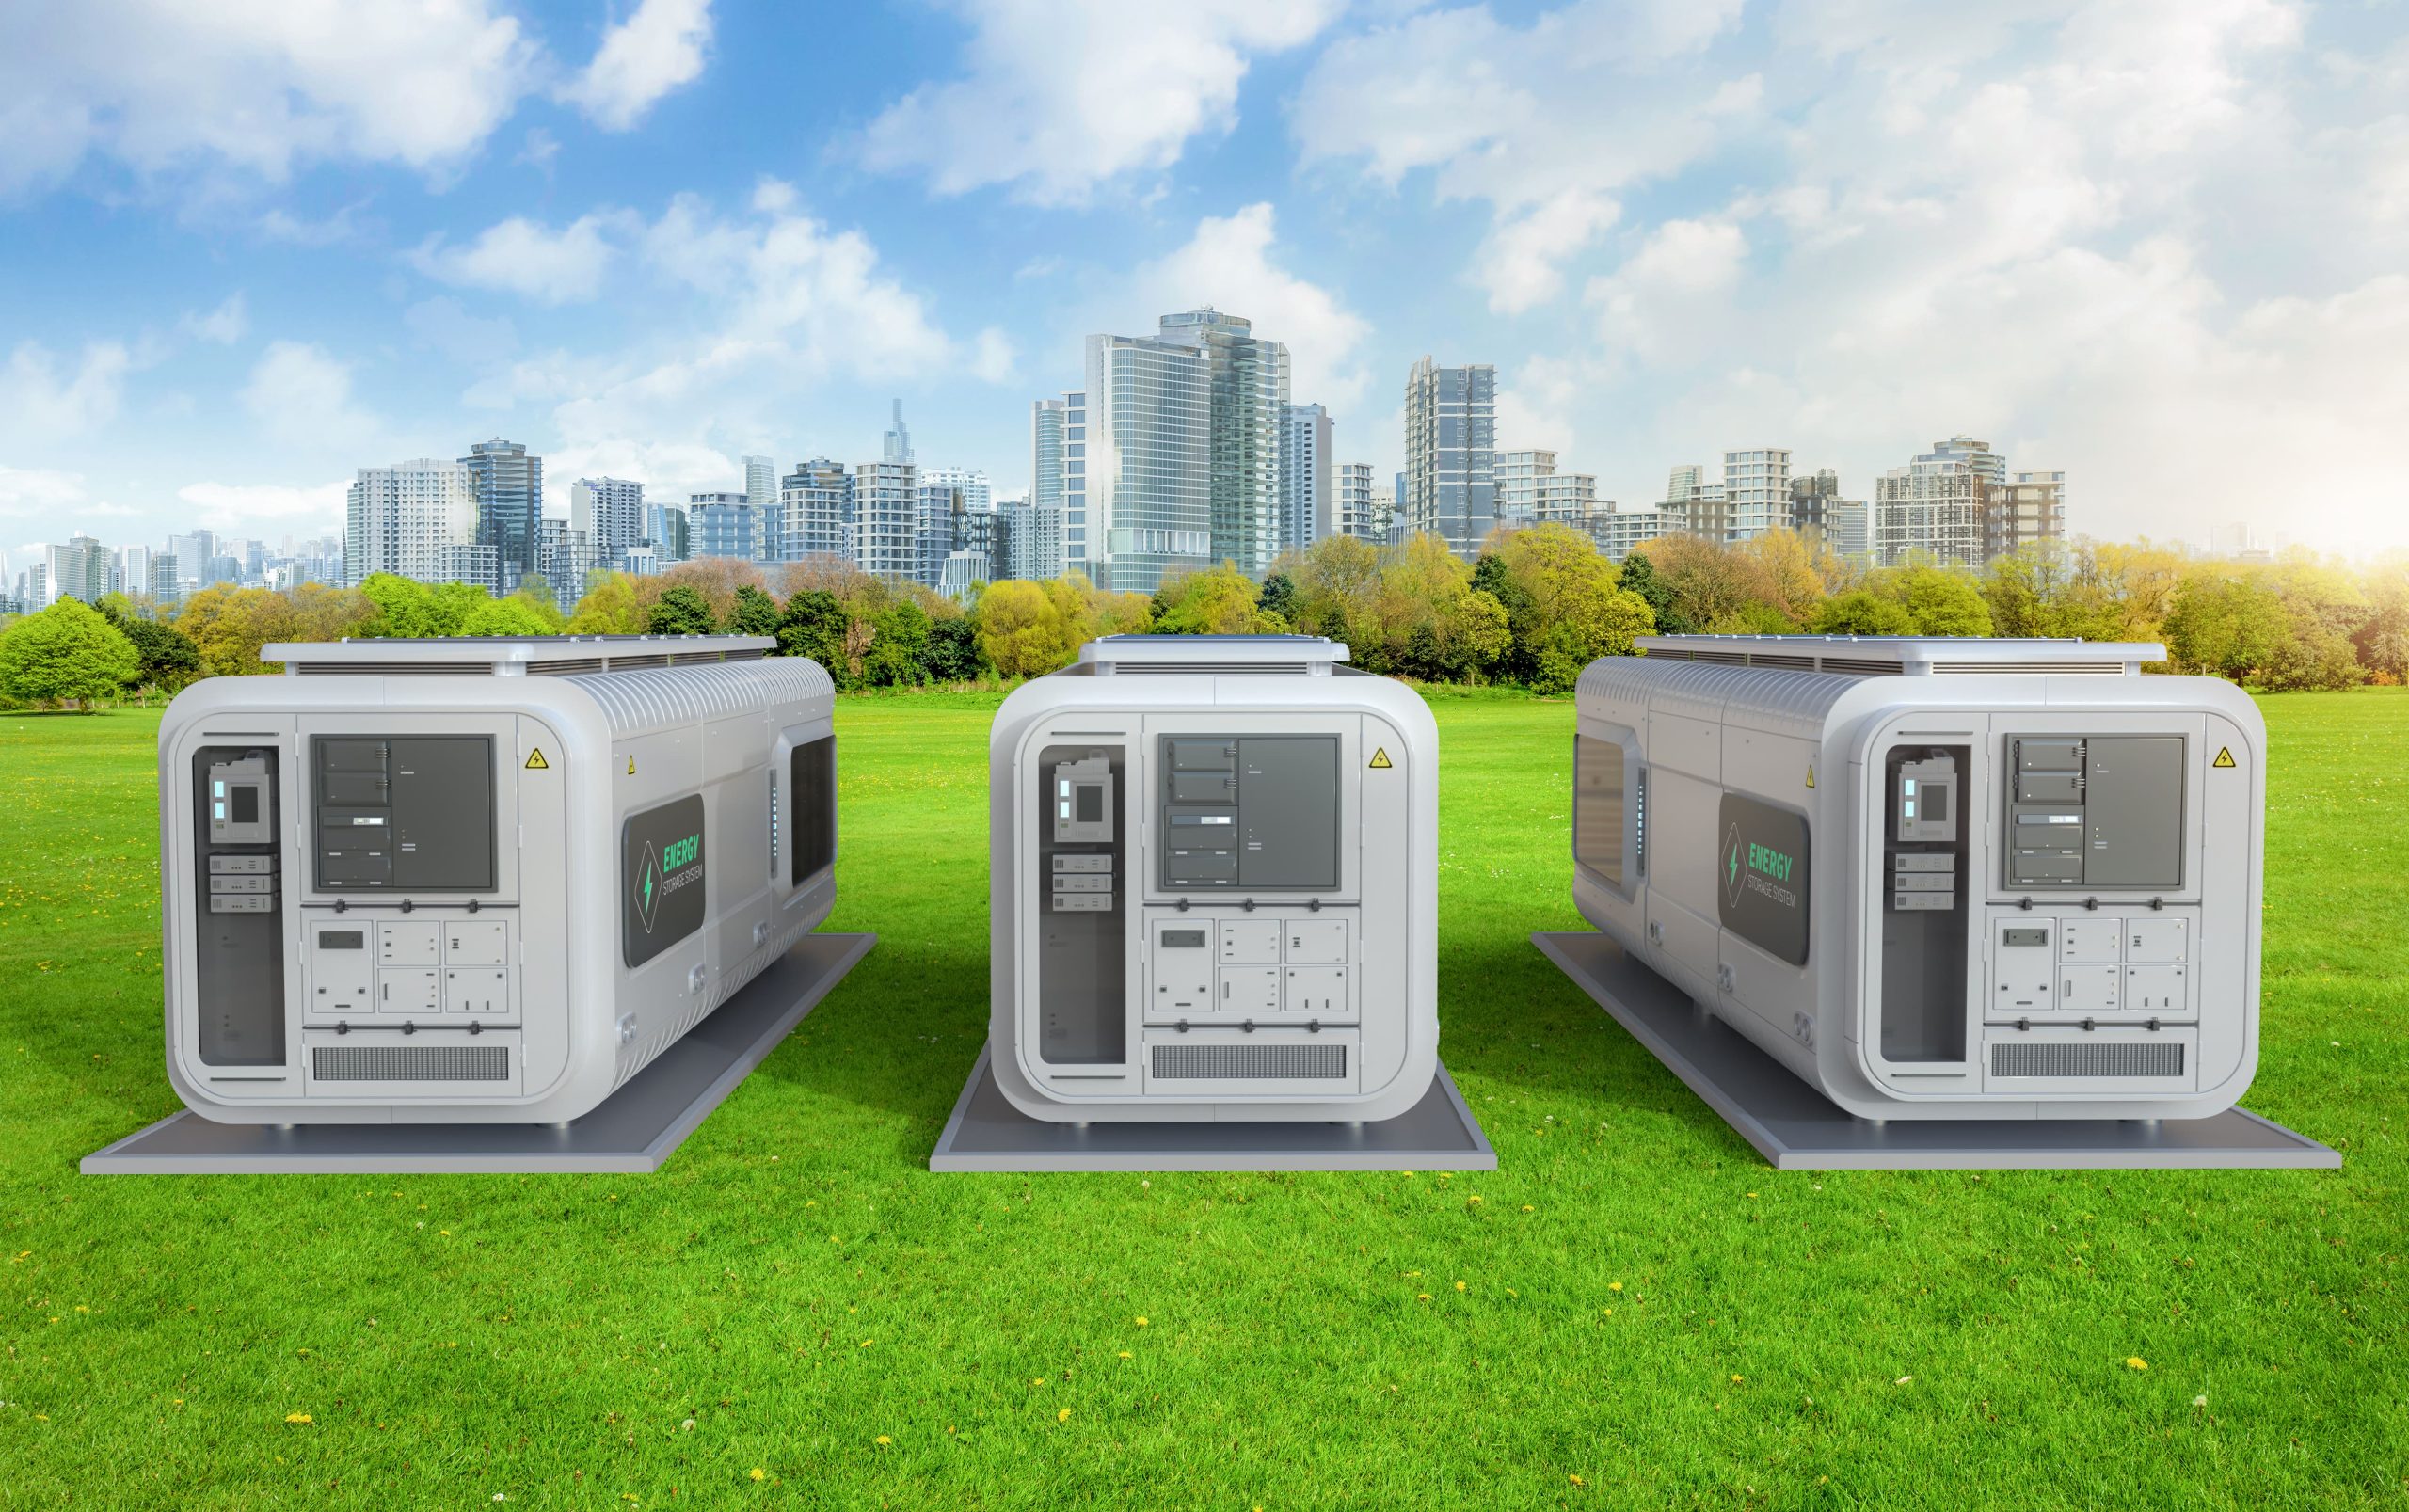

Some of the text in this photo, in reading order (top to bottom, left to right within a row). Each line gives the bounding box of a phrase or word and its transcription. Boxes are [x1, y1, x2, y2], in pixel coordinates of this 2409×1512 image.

[663, 834, 699, 873] ENERGY
[1748, 842, 1792, 882] ENERGY
[662, 864, 703, 896] STORAGE SYSTEM
[1747, 874, 1795, 908] STORAGE SYSTEM
